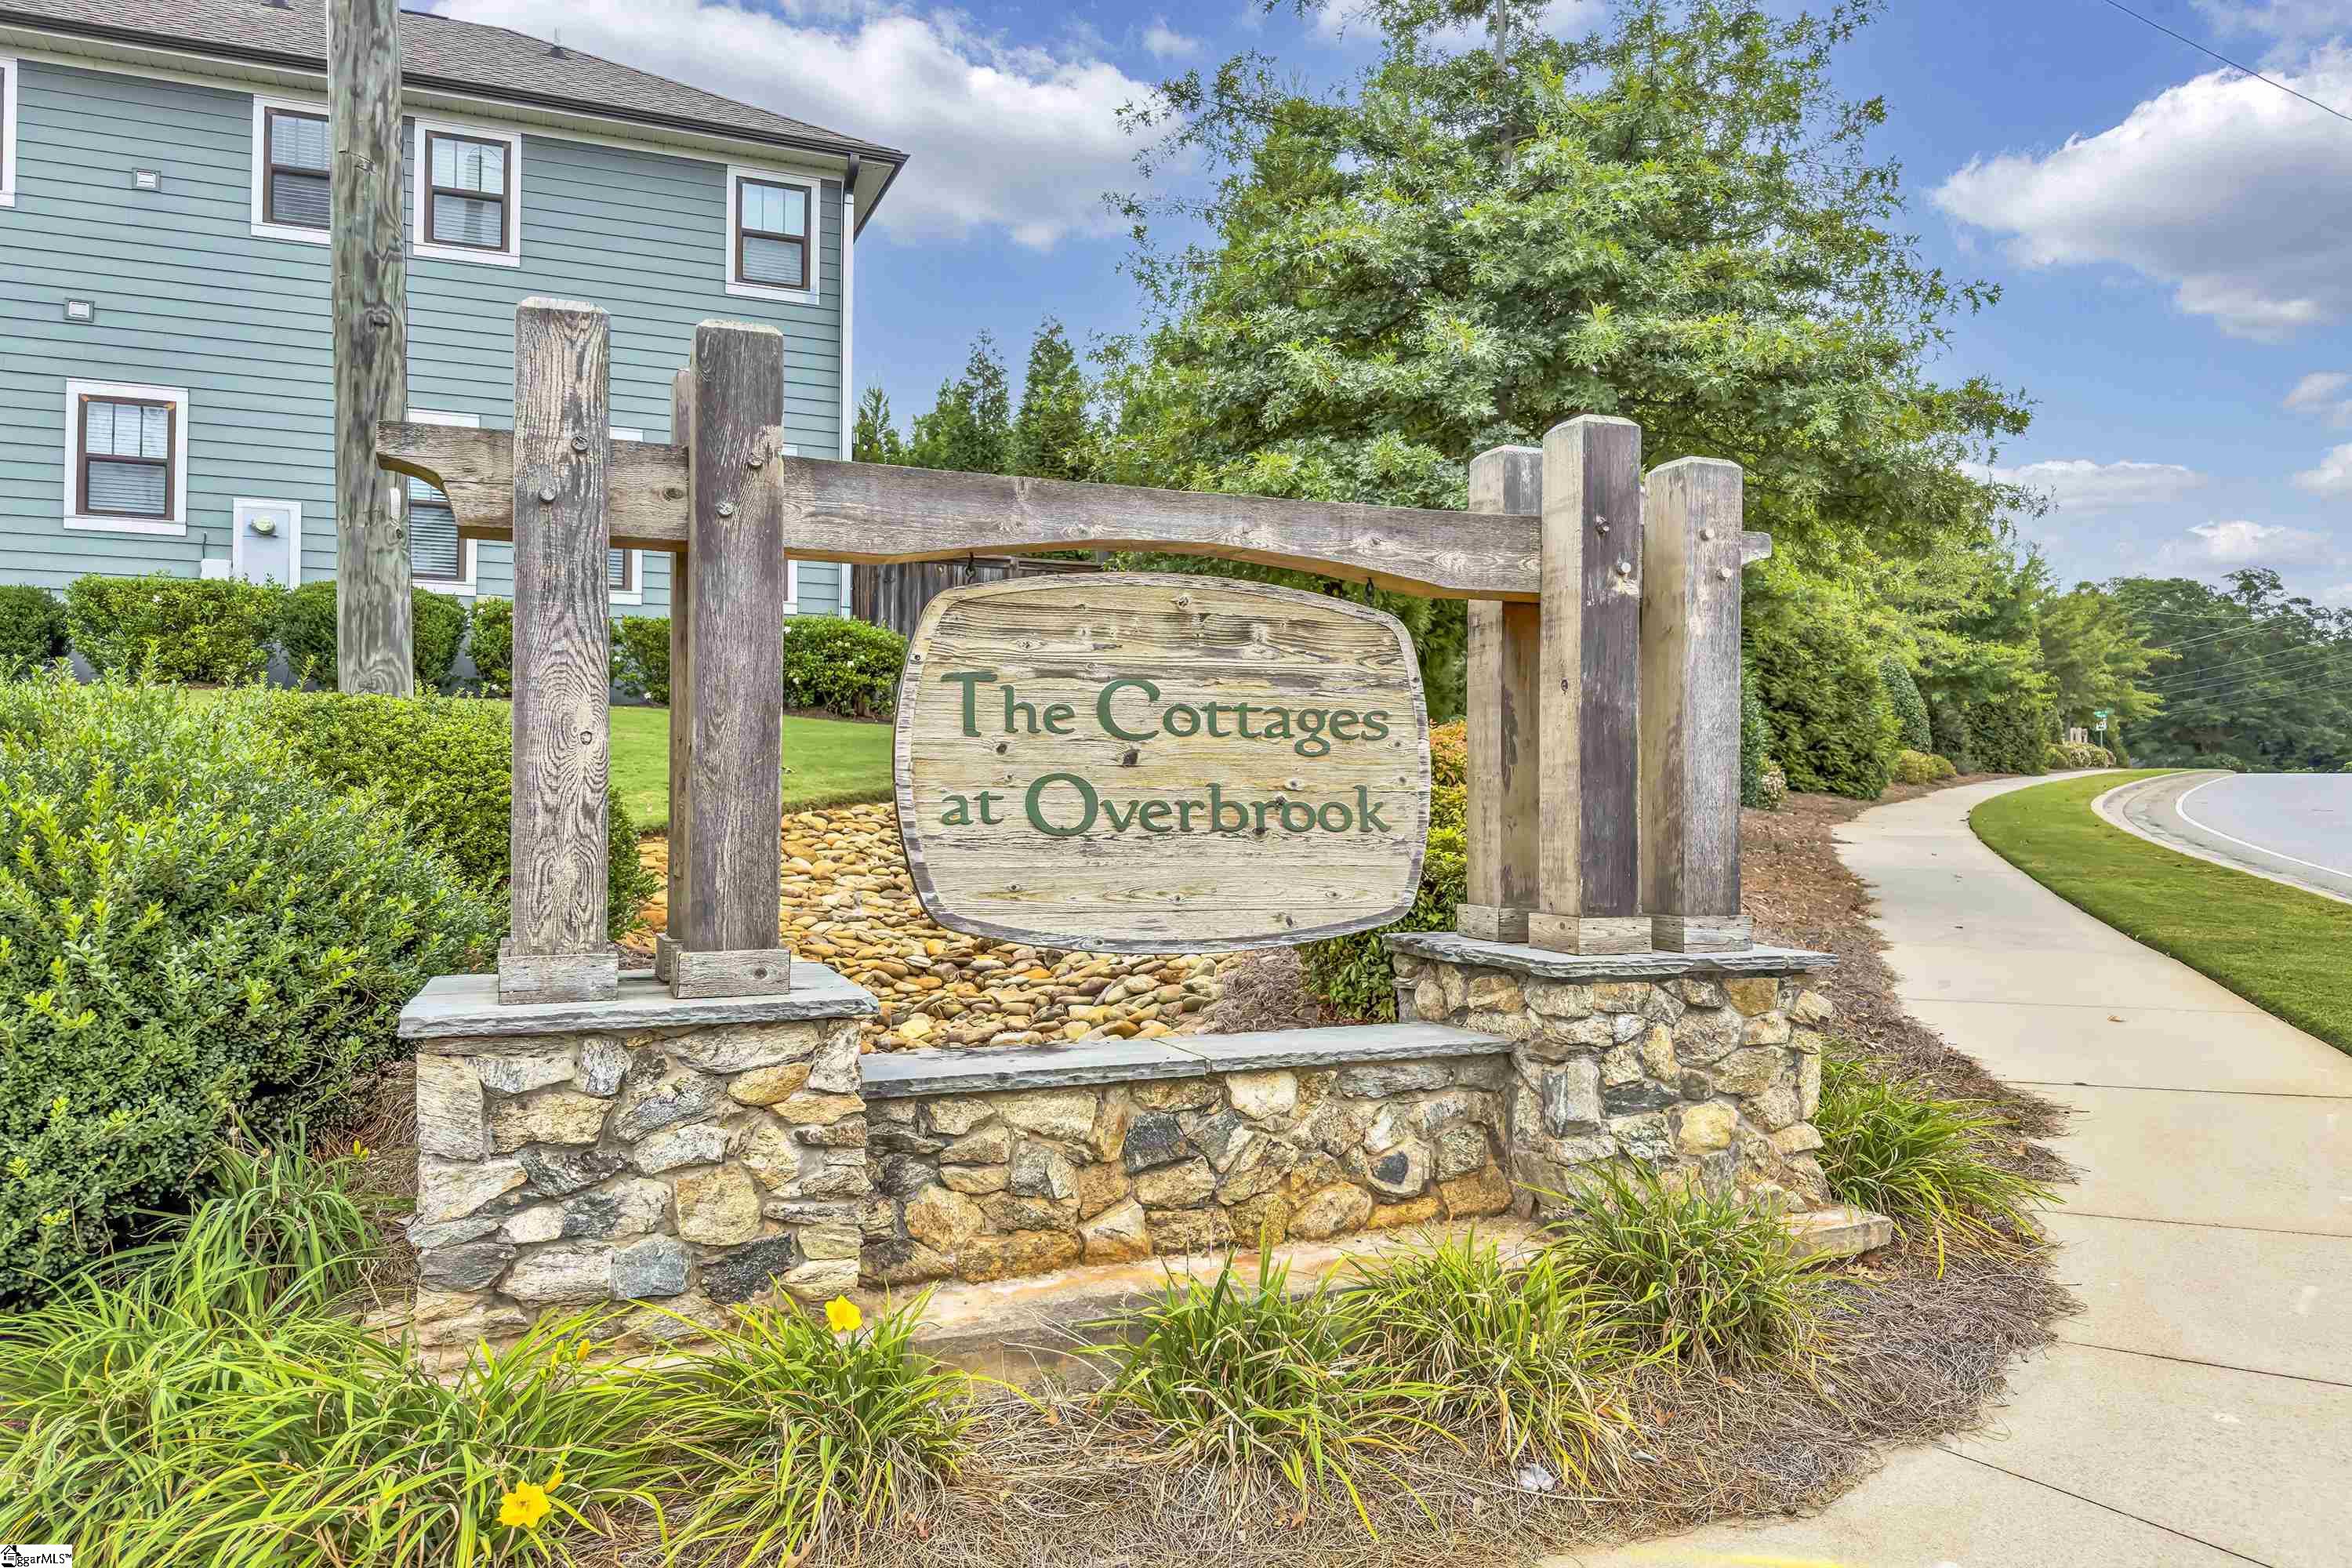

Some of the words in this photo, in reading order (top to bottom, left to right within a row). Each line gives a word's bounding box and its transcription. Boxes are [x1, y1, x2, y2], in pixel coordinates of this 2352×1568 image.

[941, 670, 1076, 739] The
[1098, 678, 1391, 757] Cottages
[941, 789, 1005, 826] at
[1025, 772, 1392, 837] Overbrook
